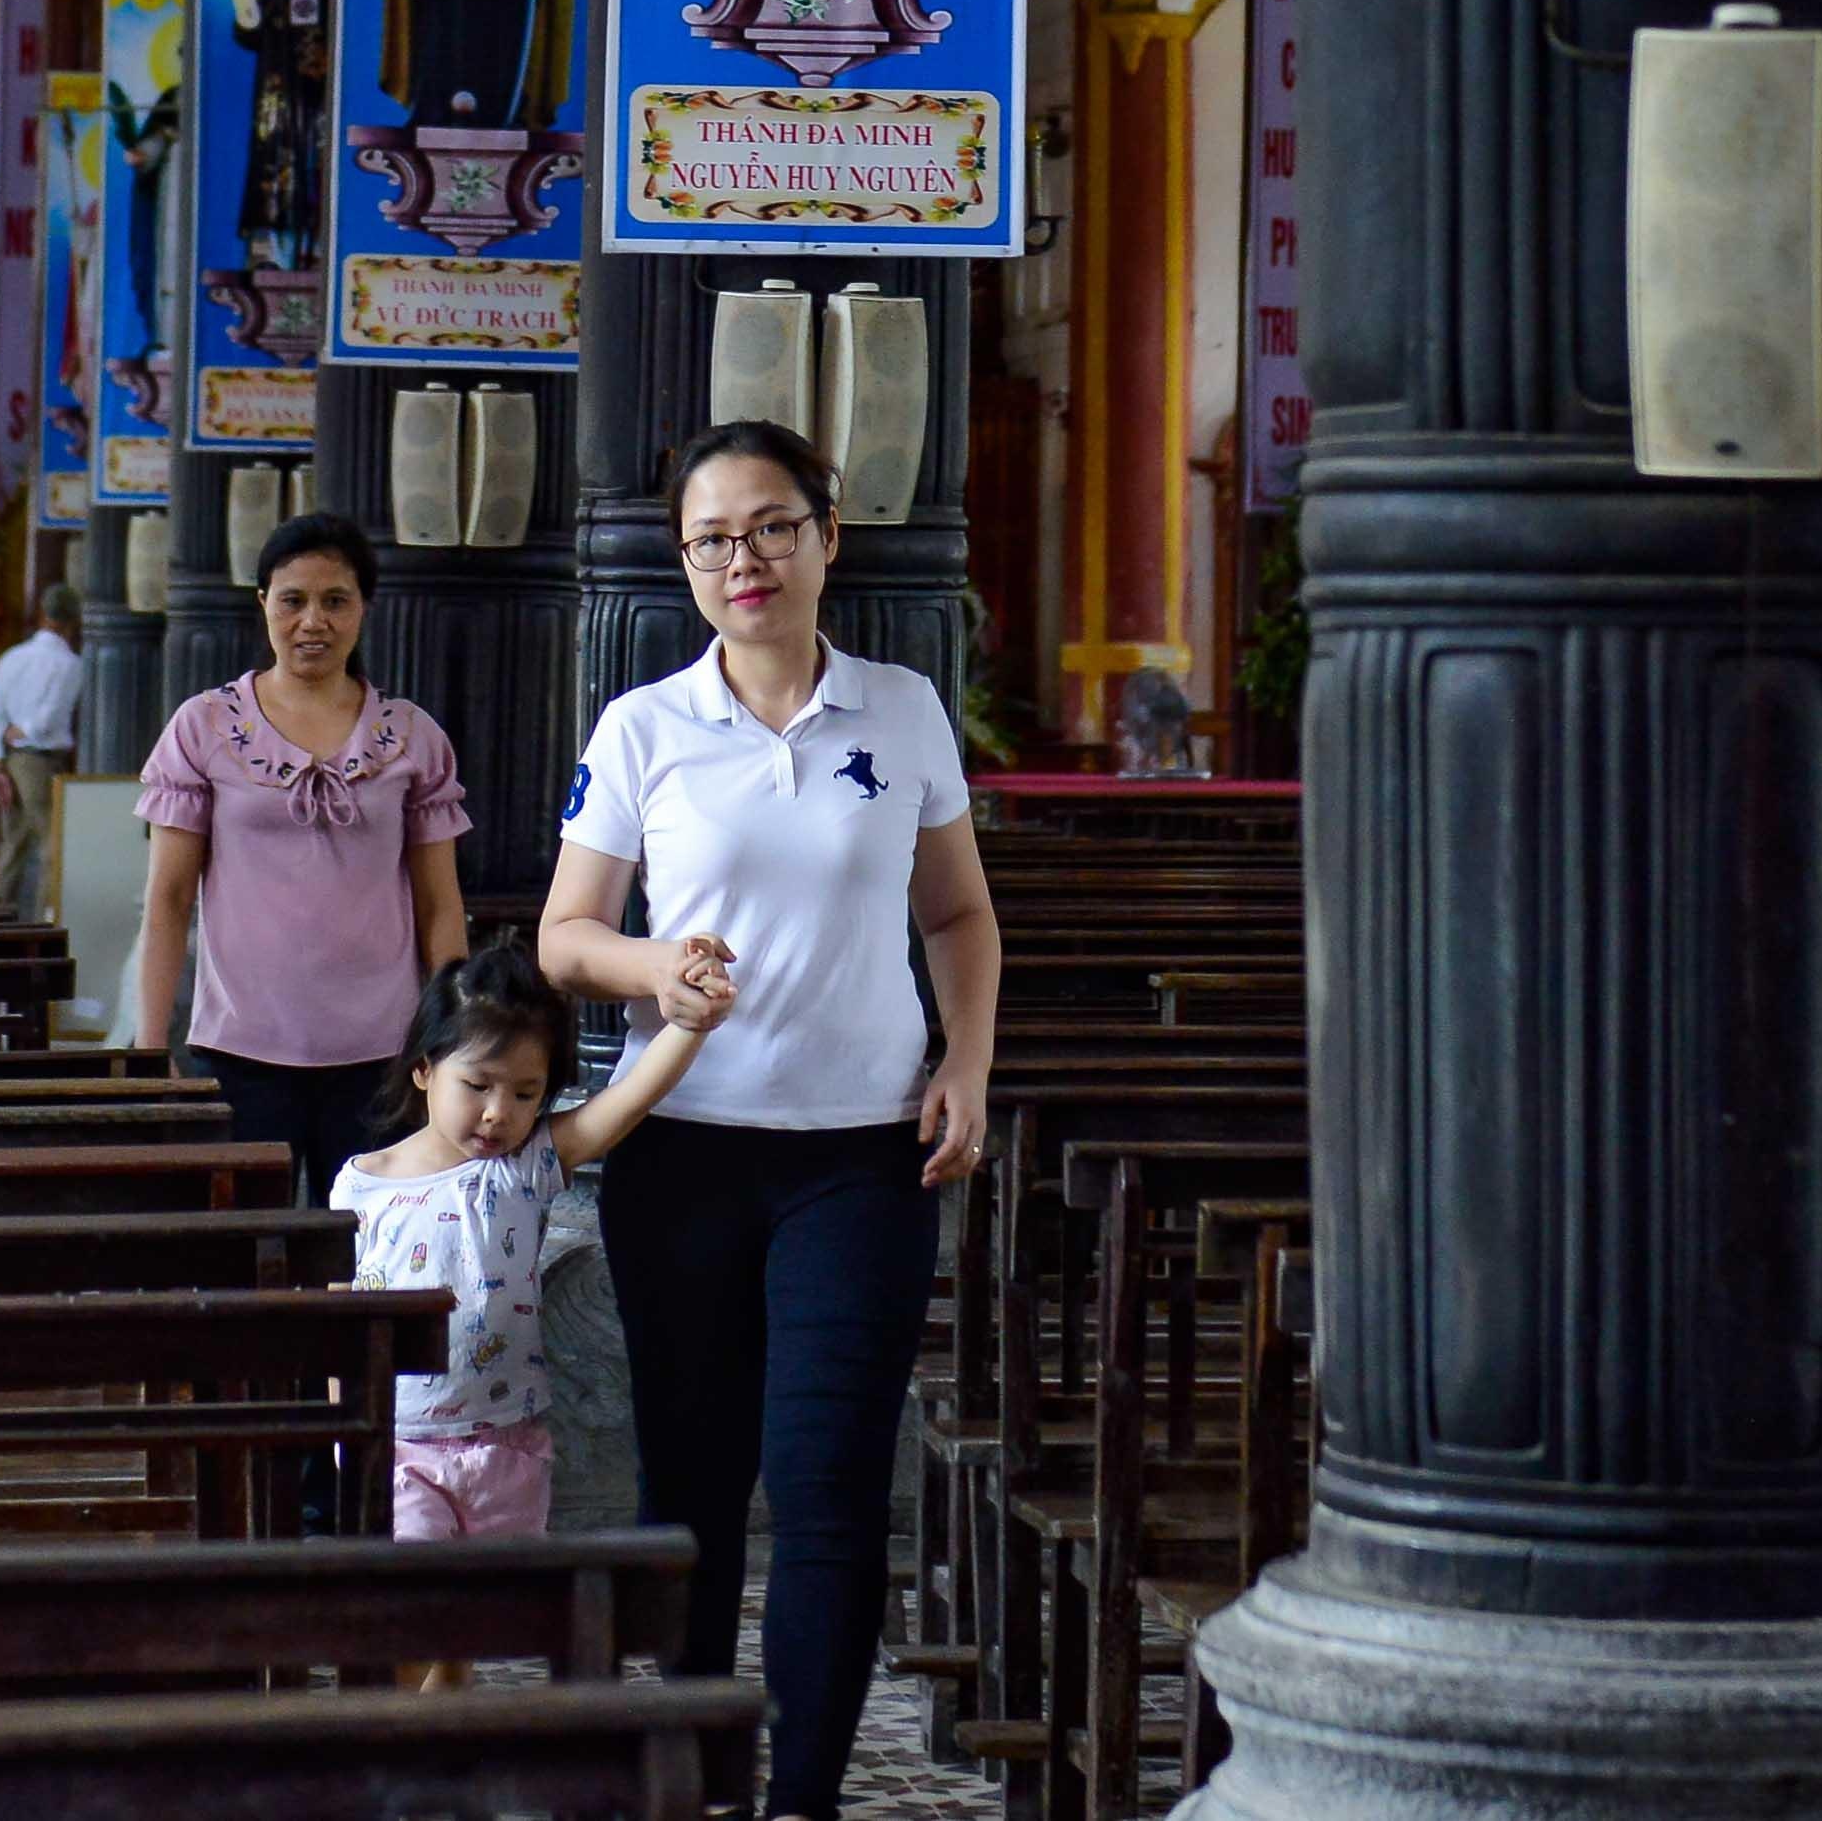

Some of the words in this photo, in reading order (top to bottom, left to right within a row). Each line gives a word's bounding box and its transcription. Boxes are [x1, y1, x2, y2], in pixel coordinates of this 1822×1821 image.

[697, 115, 798, 145] THÁNH
[807, 122, 846, 146] ĐA
[855, 123, 933, 148] MINH
[669, 152, 780, 191] NGUYỄN
[786, 165, 842, 192] HUY
[848, 159, 959, 194] NGUYÊN
[493, 282, 543, 298] MINH
